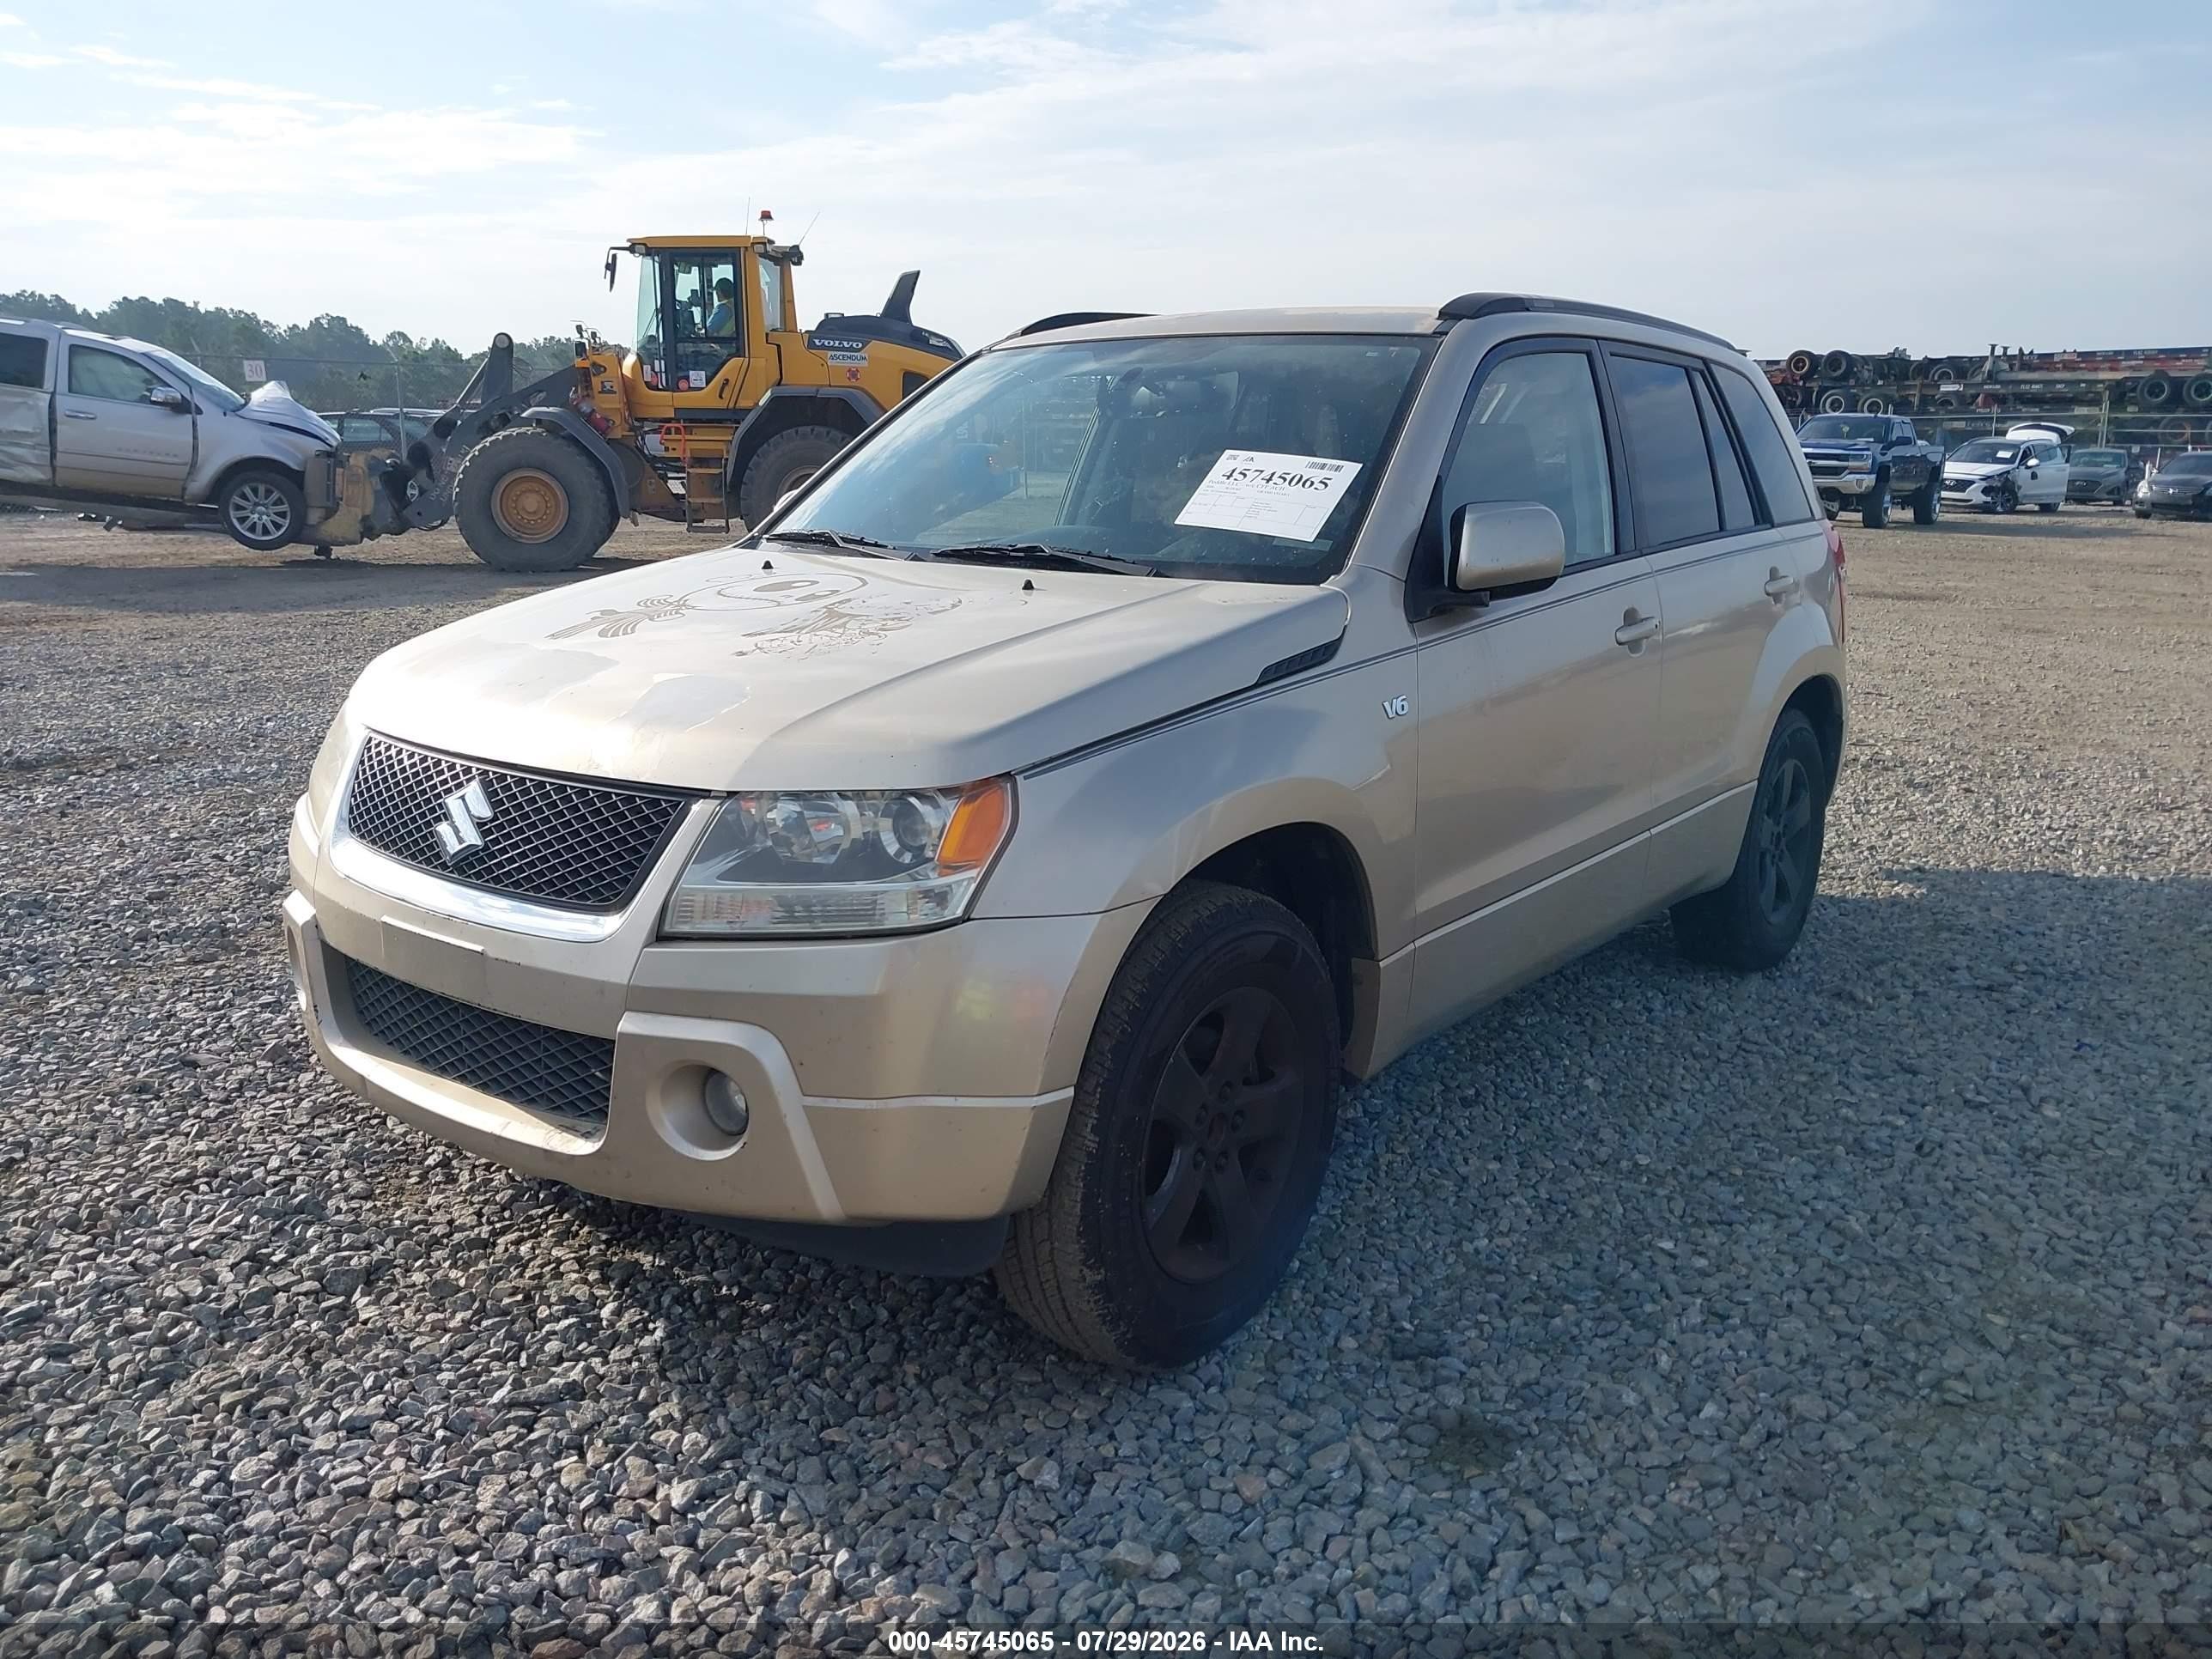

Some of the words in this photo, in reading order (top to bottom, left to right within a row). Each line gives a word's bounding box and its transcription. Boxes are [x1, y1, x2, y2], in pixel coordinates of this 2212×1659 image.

[812, 338, 863, 349] VOLVO
[247, 363, 263, 378] 30
[1222, 466, 1334, 491] 45745065
[1382, 695, 1409, 720] V6
